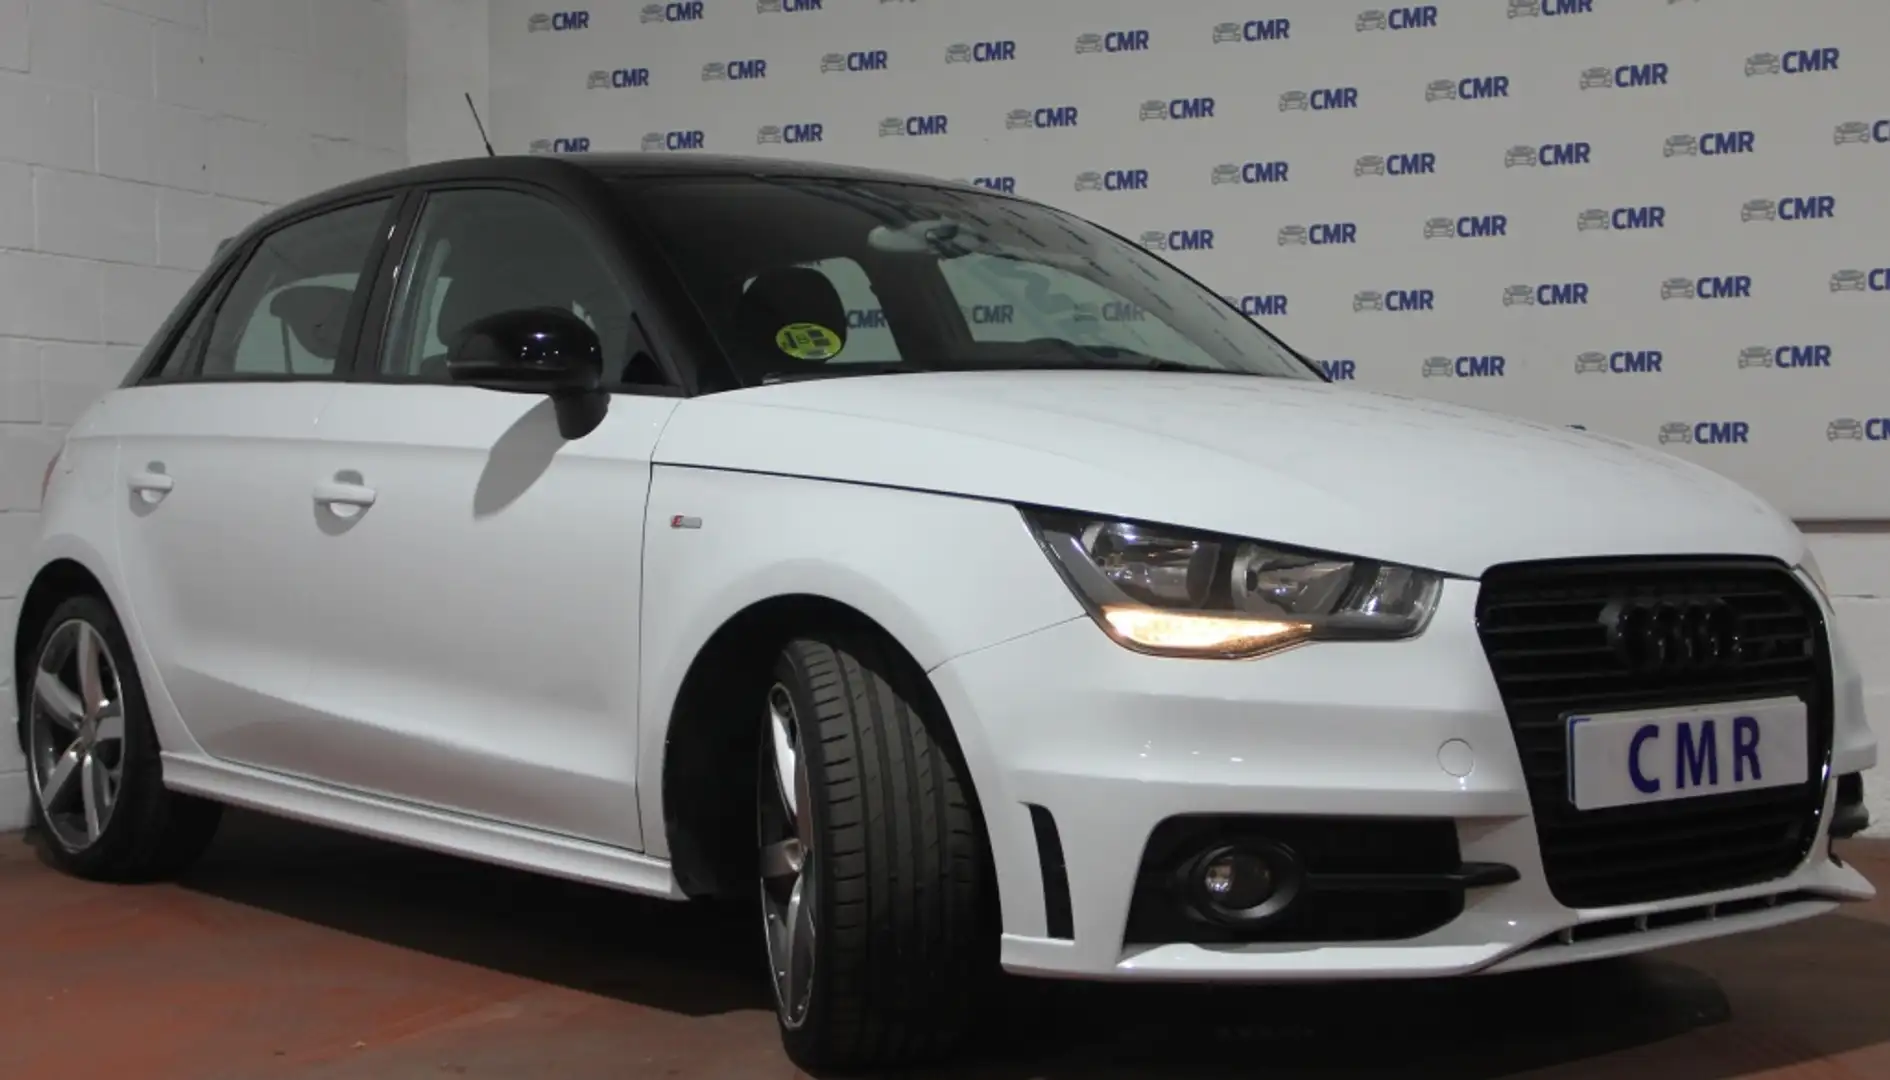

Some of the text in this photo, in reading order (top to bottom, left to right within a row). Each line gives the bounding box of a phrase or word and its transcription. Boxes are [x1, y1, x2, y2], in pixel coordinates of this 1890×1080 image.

[552, 11, 589, 30] CMR
[666, 1, 703, 21] CMR
[1389, 6, 1437, 30] CMR
[1243, 19, 1289, 41] CMR
[973, 41, 1015, 62] CMR
[1105, 30, 1149, 52] CMR
[728, 60, 766, 80] CMR
[847, 51, 887, 71] CMR
[1783, 48, 1839, 73] CMR
[612, 68, 648, 88] CMR
[1615, 63, 1668, 87] CMR
[1459, 76, 1508, 99] CMR
[1169, 98, 1214, 119] CMR
[1310, 88, 1357, 110] CMR
[906, 115, 947, 136] CMR
[1034, 107, 1077, 128] CMR
[667, 131, 704, 150] CMR
[783, 124, 822, 143] CMR
[1700, 131, 1754, 155] CMR
[554, 138, 589, 152] CMR
[1539, 143, 1590, 166] CMR
[1242, 162, 1288, 183] CMR
[1387, 153, 1435, 175] CMR
[1104, 170, 1148, 190] CMR
[1612, 207, 1665, 229] CMR
[1778, 196, 1834, 220] CMR
[1309, 223, 1356, 244] CMR
[1457, 215, 1506, 237] CMR
[1169, 230, 1213, 250] CMR
[1537, 283, 1588, 305] CMR
[1697, 276, 1751, 299] CMR
[1241, 295, 1287, 316] CMR
[1385, 290, 1433, 311] CMR
[846, 309, 886, 328] CMR
[972, 305, 1013, 324] CMR
[1455, 356, 1505, 377] CMR
[1610, 351, 1662, 373] CMR
[1775, 345, 1831, 368] CMR
[1316, 360, 1355, 380] MR
[1695, 422, 1748, 444] CMR
